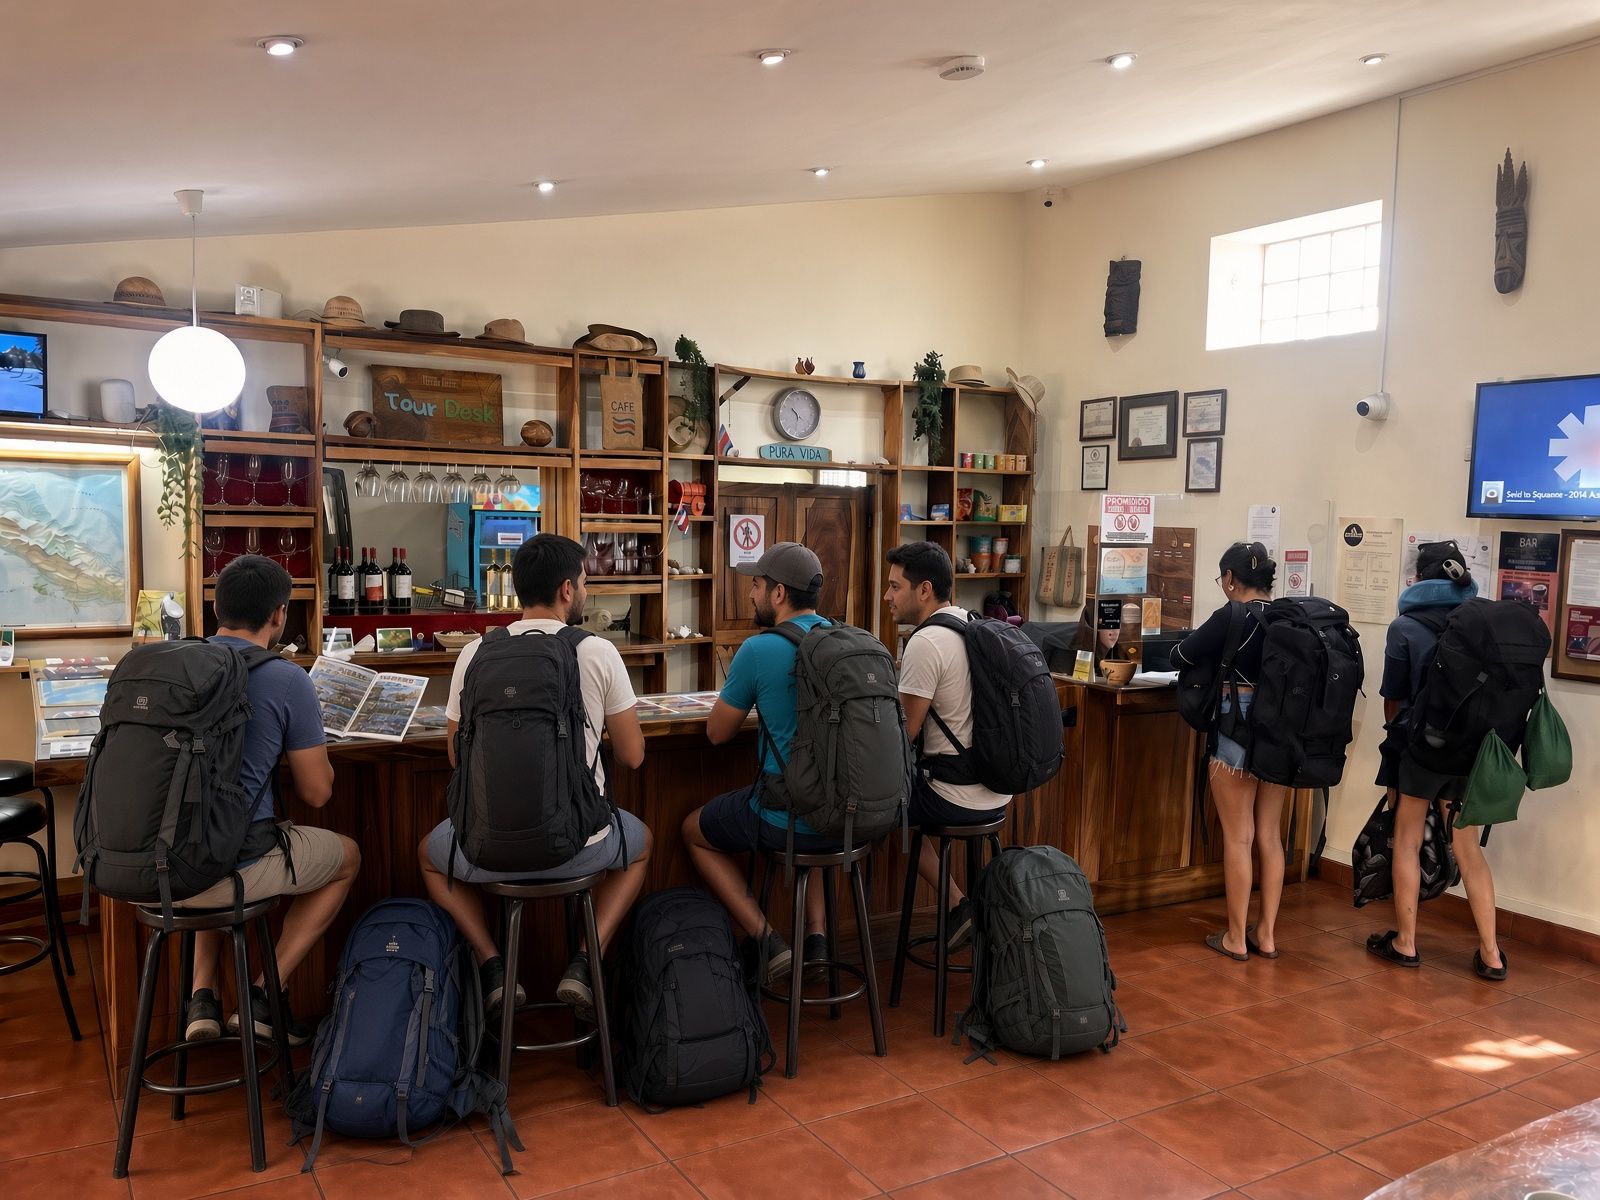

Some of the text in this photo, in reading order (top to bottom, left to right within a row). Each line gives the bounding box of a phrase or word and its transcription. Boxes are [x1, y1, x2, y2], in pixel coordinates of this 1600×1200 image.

[384, 392, 495, 424] Tour Desk
[610, 400, 635, 412] CAFE
[769, 445, 822, 461] PURA VIDA
[1568, 490, 1587, 499] 2014
[1519, 537, 1538, 548] BAR
